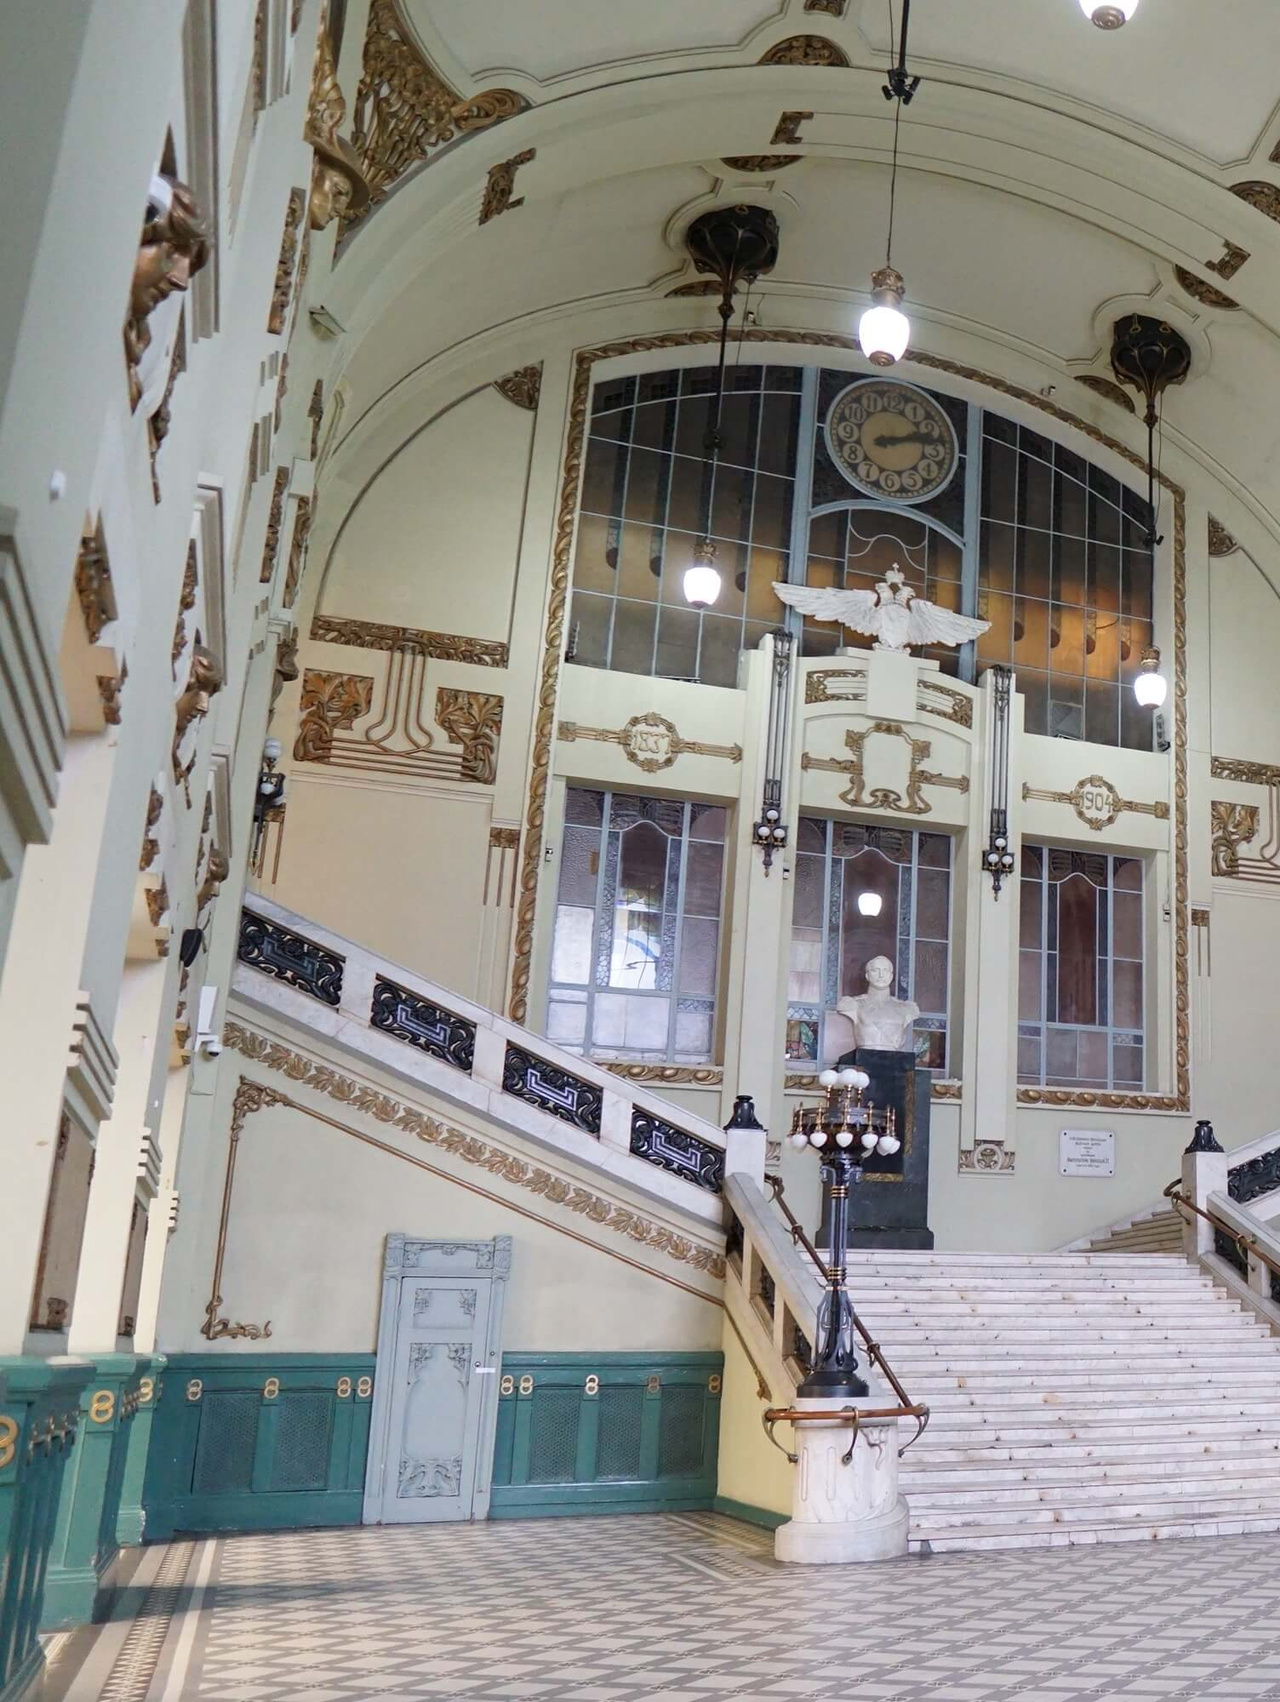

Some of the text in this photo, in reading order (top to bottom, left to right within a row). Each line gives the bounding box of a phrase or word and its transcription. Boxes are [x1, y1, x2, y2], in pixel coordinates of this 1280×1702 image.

[866, 395, 878, 411] 11
[847, 405, 863, 421] 10
[843, 424, 854, 440] 9
[848, 445, 858, 461] 8
[929, 443, 940, 458] 3
[864, 463, 873, 479] 7
[922, 462, 932, 478] 4
[884, 473, 895, 489] 6
[905, 472, 917, 488] 5
[1079, 790, 1114, 814] 1904
